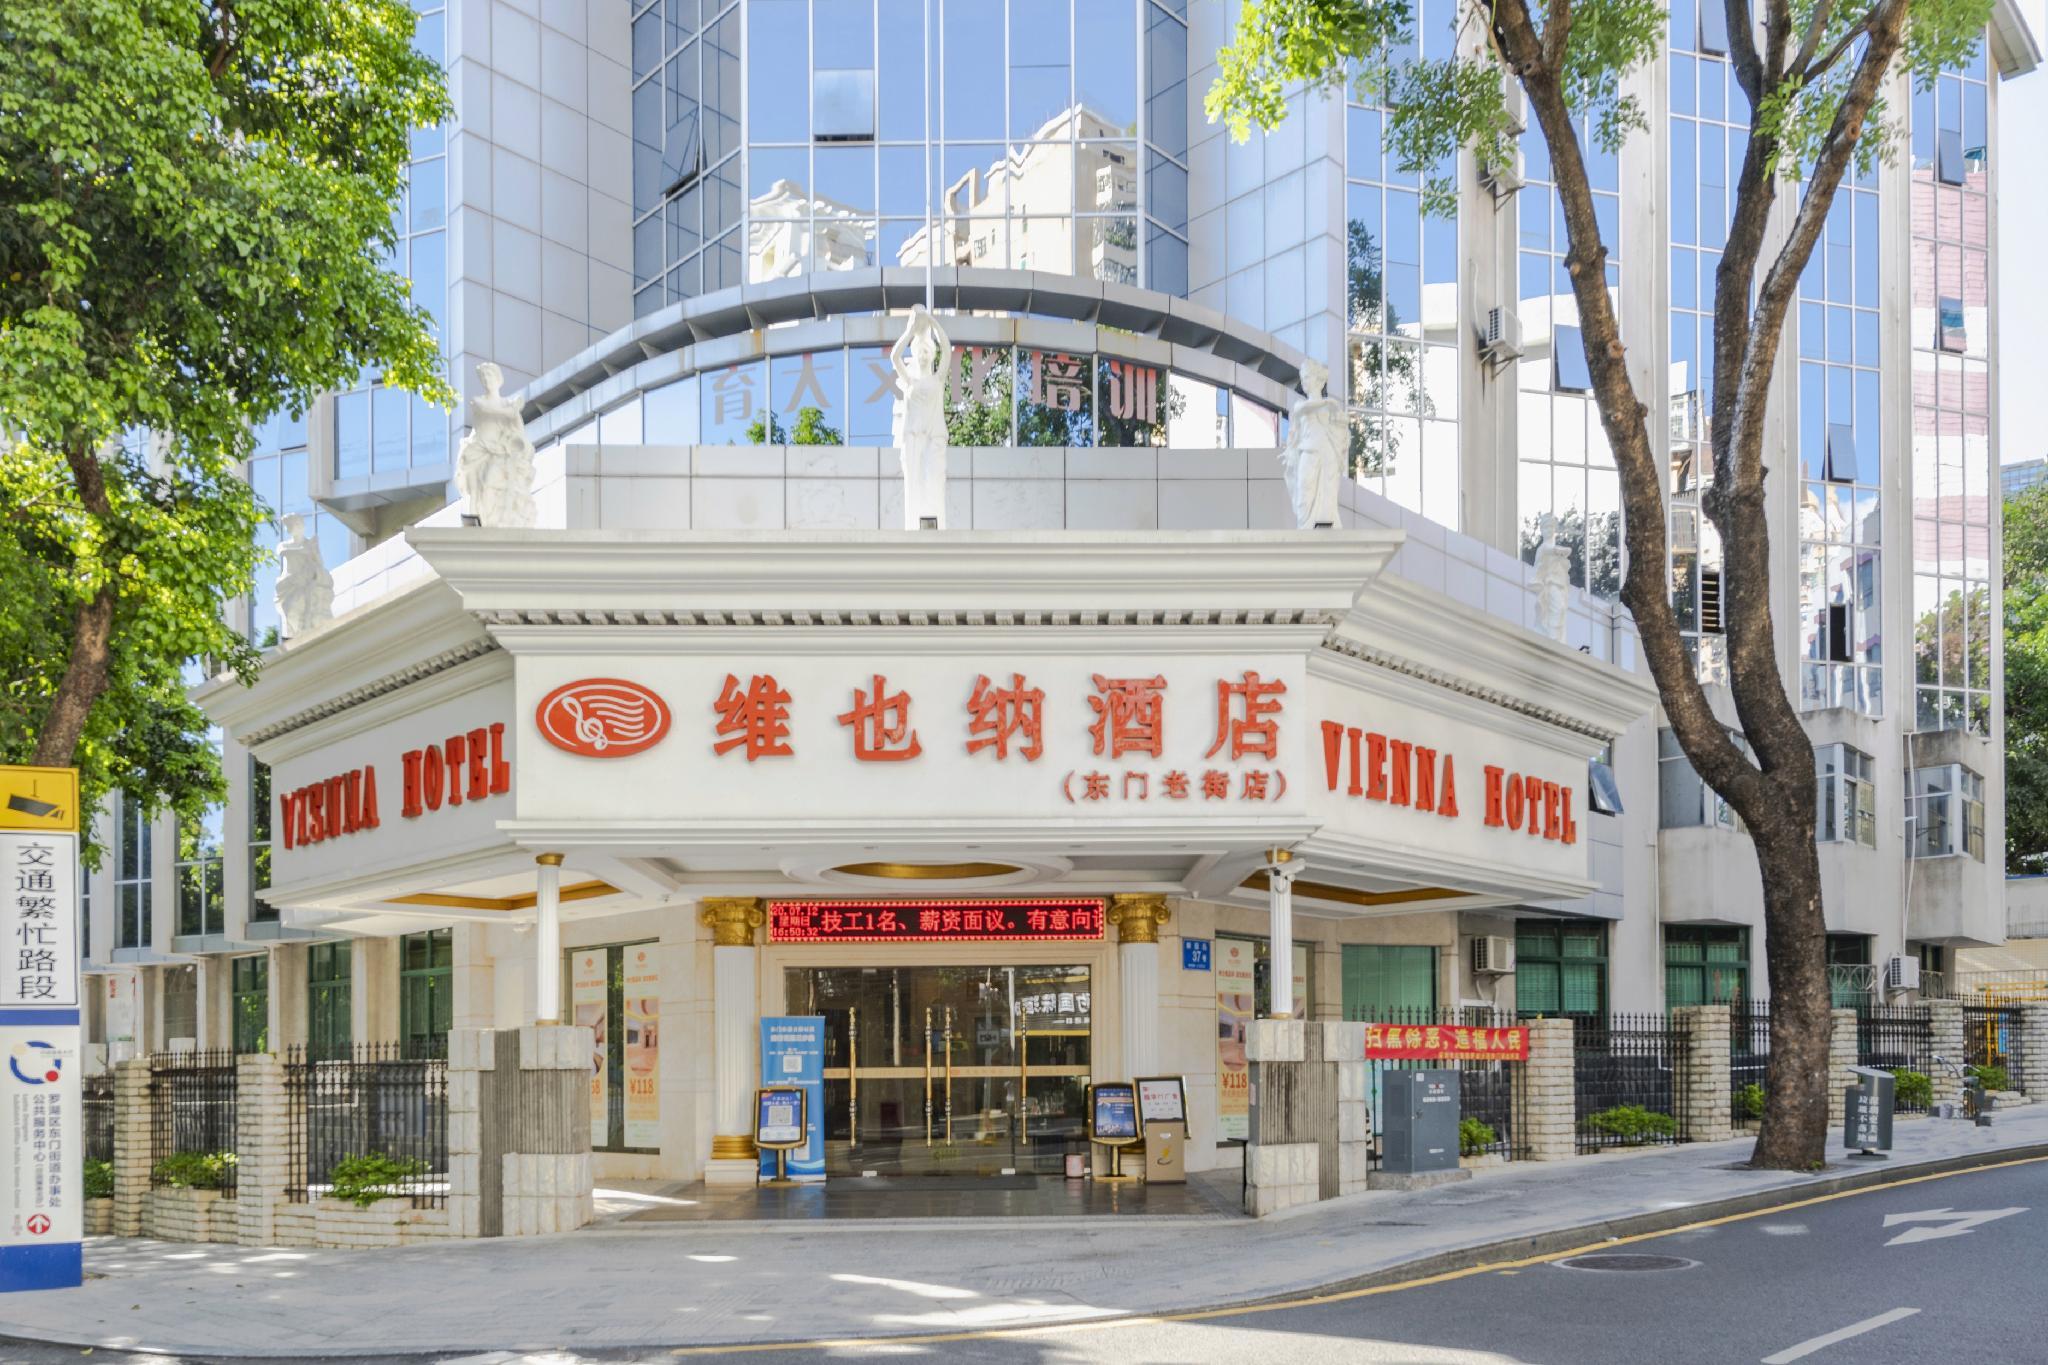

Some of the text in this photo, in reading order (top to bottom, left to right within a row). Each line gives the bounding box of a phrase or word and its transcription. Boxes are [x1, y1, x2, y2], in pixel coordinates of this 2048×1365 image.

[401, 721, 511, 819] HOTEL
[713, 671, 1288, 763] 维也纳酒店
[1320, 719, 1577, 845] VIENNA HOTEL
[16, 841, 57, 1000] 交通繁忙路段
